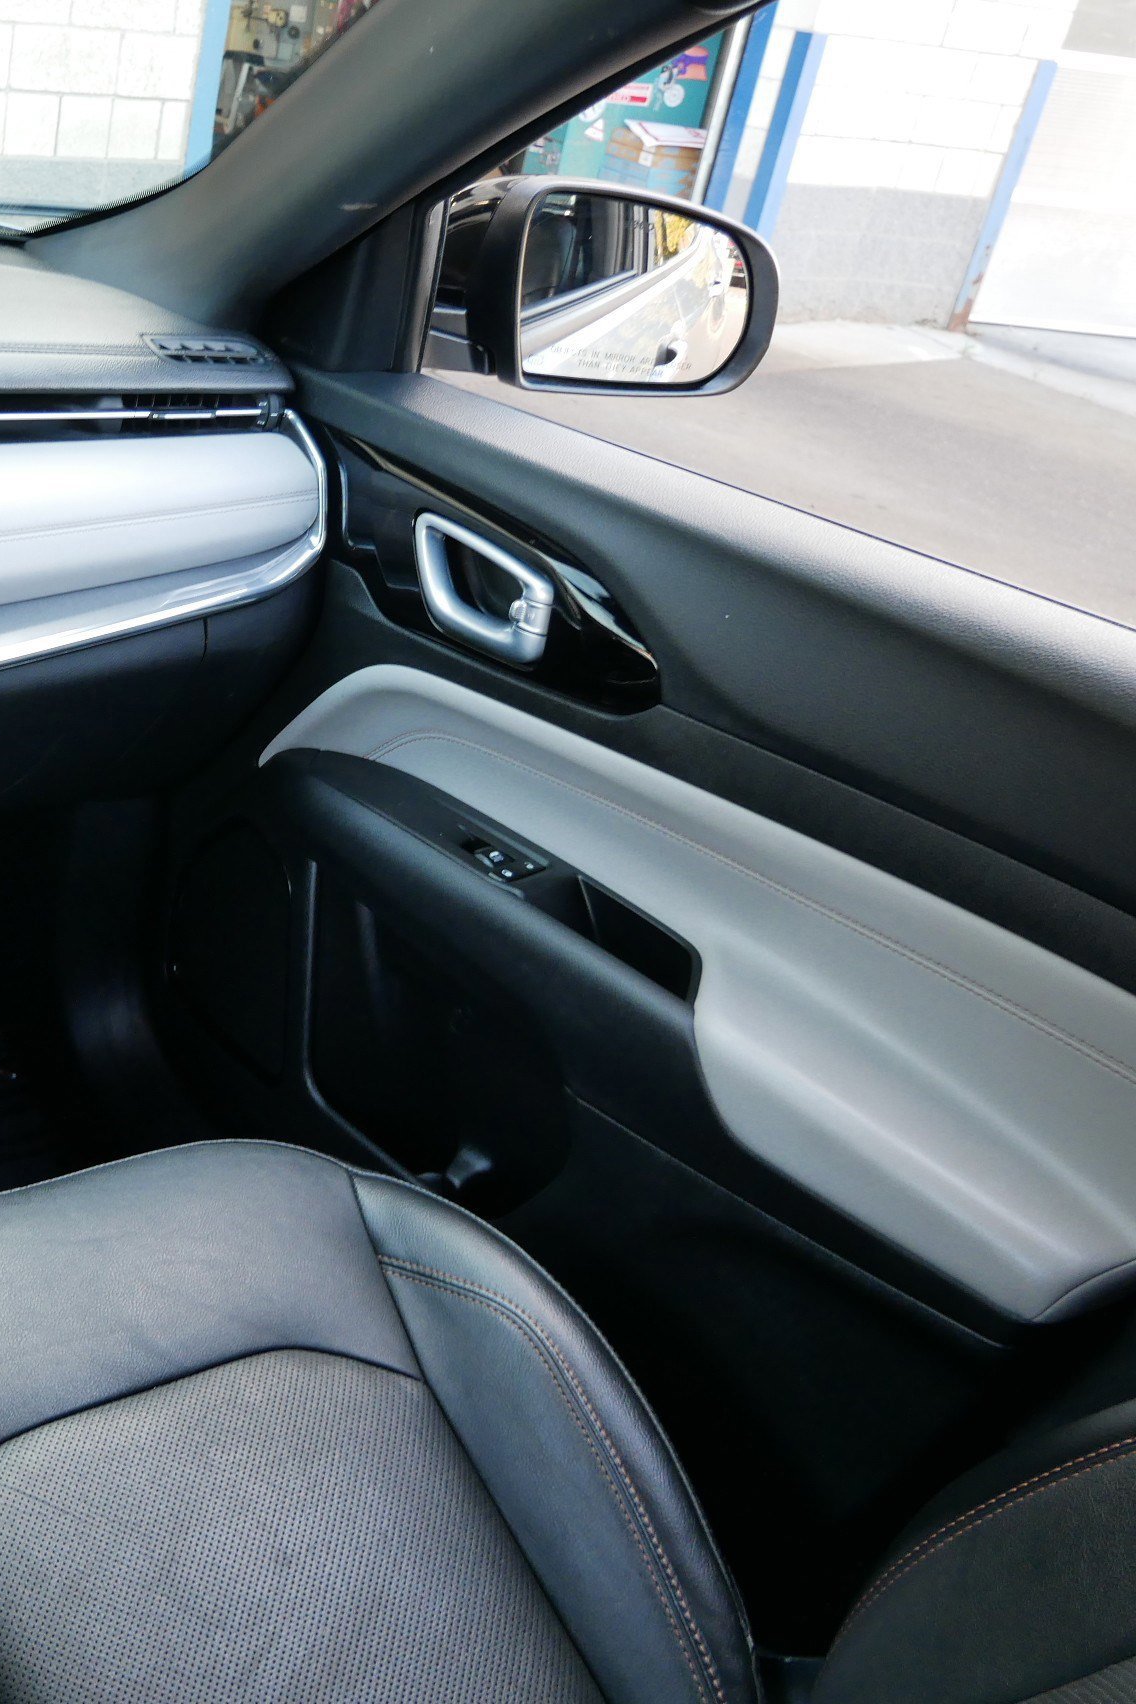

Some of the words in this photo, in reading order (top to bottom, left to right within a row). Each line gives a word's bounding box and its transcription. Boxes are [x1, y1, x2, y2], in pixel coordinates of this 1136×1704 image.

[591, 350, 600, 358] IN
[604, 352, 636, 363] MIRROR
[578, 359, 601, 369] THAN
[605, 363, 626, 371] THEY
[629, 367, 664, 376] APPEAR
